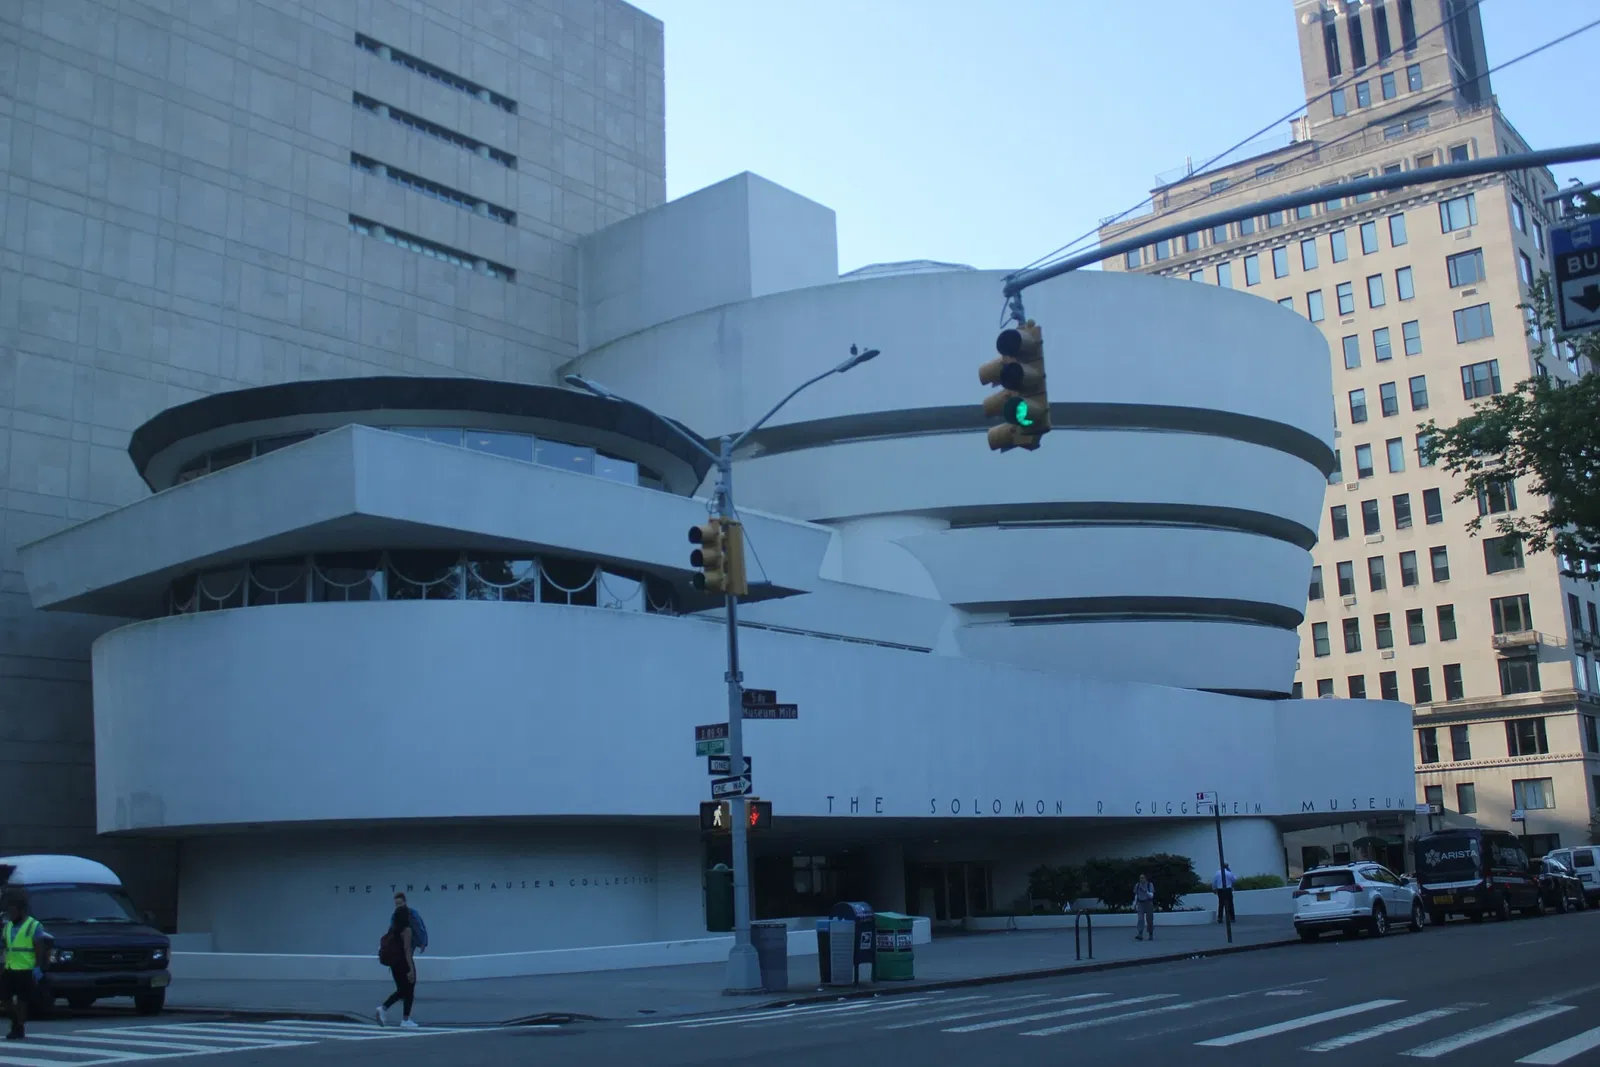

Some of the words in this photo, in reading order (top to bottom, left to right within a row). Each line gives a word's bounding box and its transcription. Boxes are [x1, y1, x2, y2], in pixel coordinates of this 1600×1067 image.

[743, 707, 776, 718] Museum
[779, 707, 797, 718] Mile
[714, 761, 727, 769] ONE
[714, 784, 726, 793] ONE
[733, 781, 746, 790] WAY
[827, 796, 883, 814] THE
[931, 798, 1063, 815] SOLOMON
[1097, 801, 1103, 814] R
[1135, 801, 1261, 814] GUGGENHEIM
[1301, 797, 1405, 812] MUSEUM
[1440, 849, 1478, 860] ARISTA
[333, 884, 372, 893] THE
[389, 879, 555, 893] THANNHAUSER
